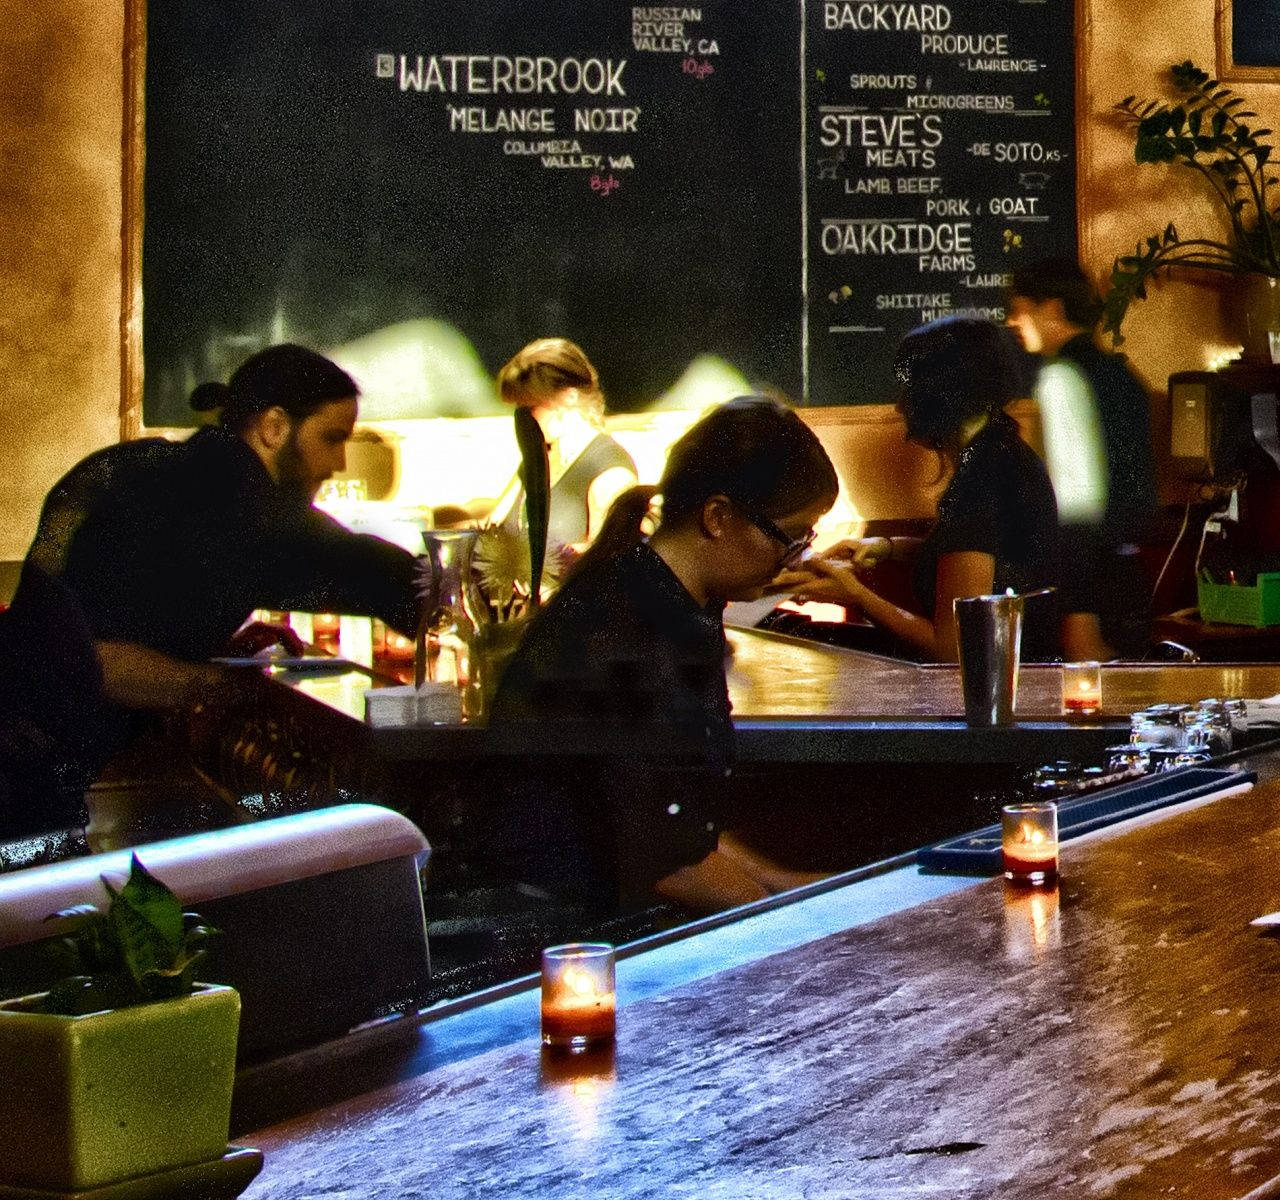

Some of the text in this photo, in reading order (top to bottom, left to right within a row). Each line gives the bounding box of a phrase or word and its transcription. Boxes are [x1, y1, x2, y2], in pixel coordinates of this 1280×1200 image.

[632, 7, 701, 22] RUSSIAN
[824, 3, 951, 32] BACKYARD
[632, 22, 684, 37] RIVER
[698, 39, 719, 55] CA
[921, 34, 1009, 55] PRODUCE
[400, 54, 627, 97] WATERBROOK
[850, 74, 917, 90] SPROUTS
[907, 94, 1015, 110] MICROGREENS
[819, 113, 943, 147] STEVE'S
[503, 139, 582, 155] COLUMBIA
[609, 155, 635, 170] WA
[866, 150, 936, 168] MEATS
[926, 199, 970, 216] PORK
[989, 197, 1039, 215] GOAT
[821, 223, 973, 255] OAKRIDGE
[919, 255, 976, 272] FARMS
[960, 274, 1012, 288] -LAWRE
[876, 294, 951, 309] SHIITAKE
